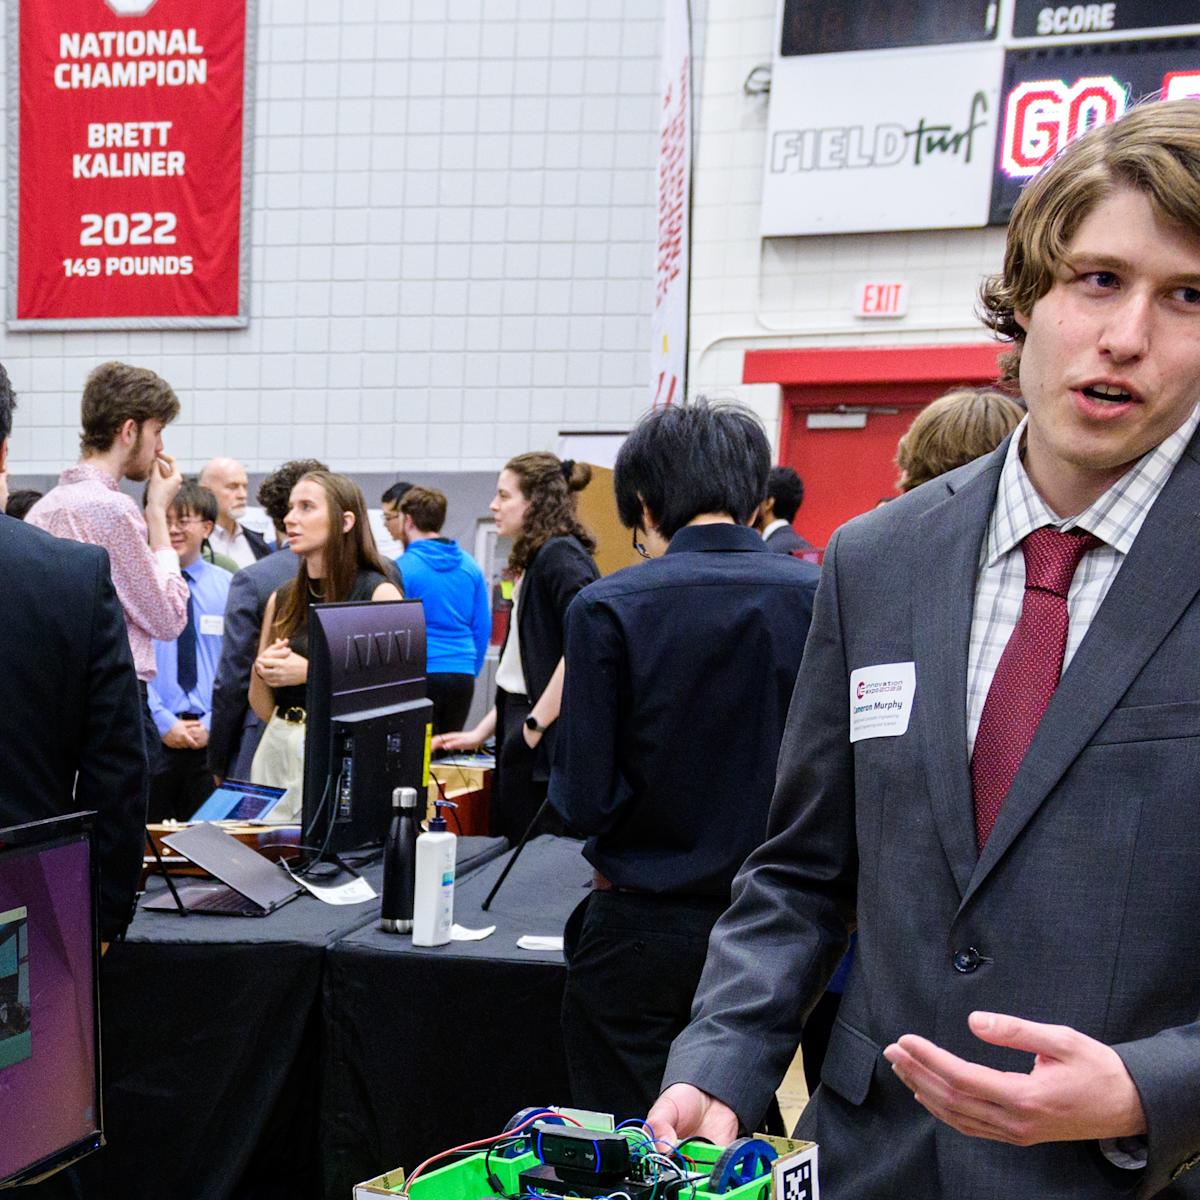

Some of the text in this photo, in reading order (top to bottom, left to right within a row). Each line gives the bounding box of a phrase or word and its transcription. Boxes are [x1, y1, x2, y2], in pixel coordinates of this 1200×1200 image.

[1037, 3, 1116, 34] SCORE
[60, 28, 204, 59] NATIONAL
[54, 59, 207, 90] CHAMPION
[87, 121, 173, 149] BRETT
[72, 151, 185, 179] KALINER
[79, 211, 177, 247] 2022
[62, 255, 193, 277] 149 POUNDS
[862, 284, 902, 312] EXIT
[874, 700, 903, 710] Murphy
